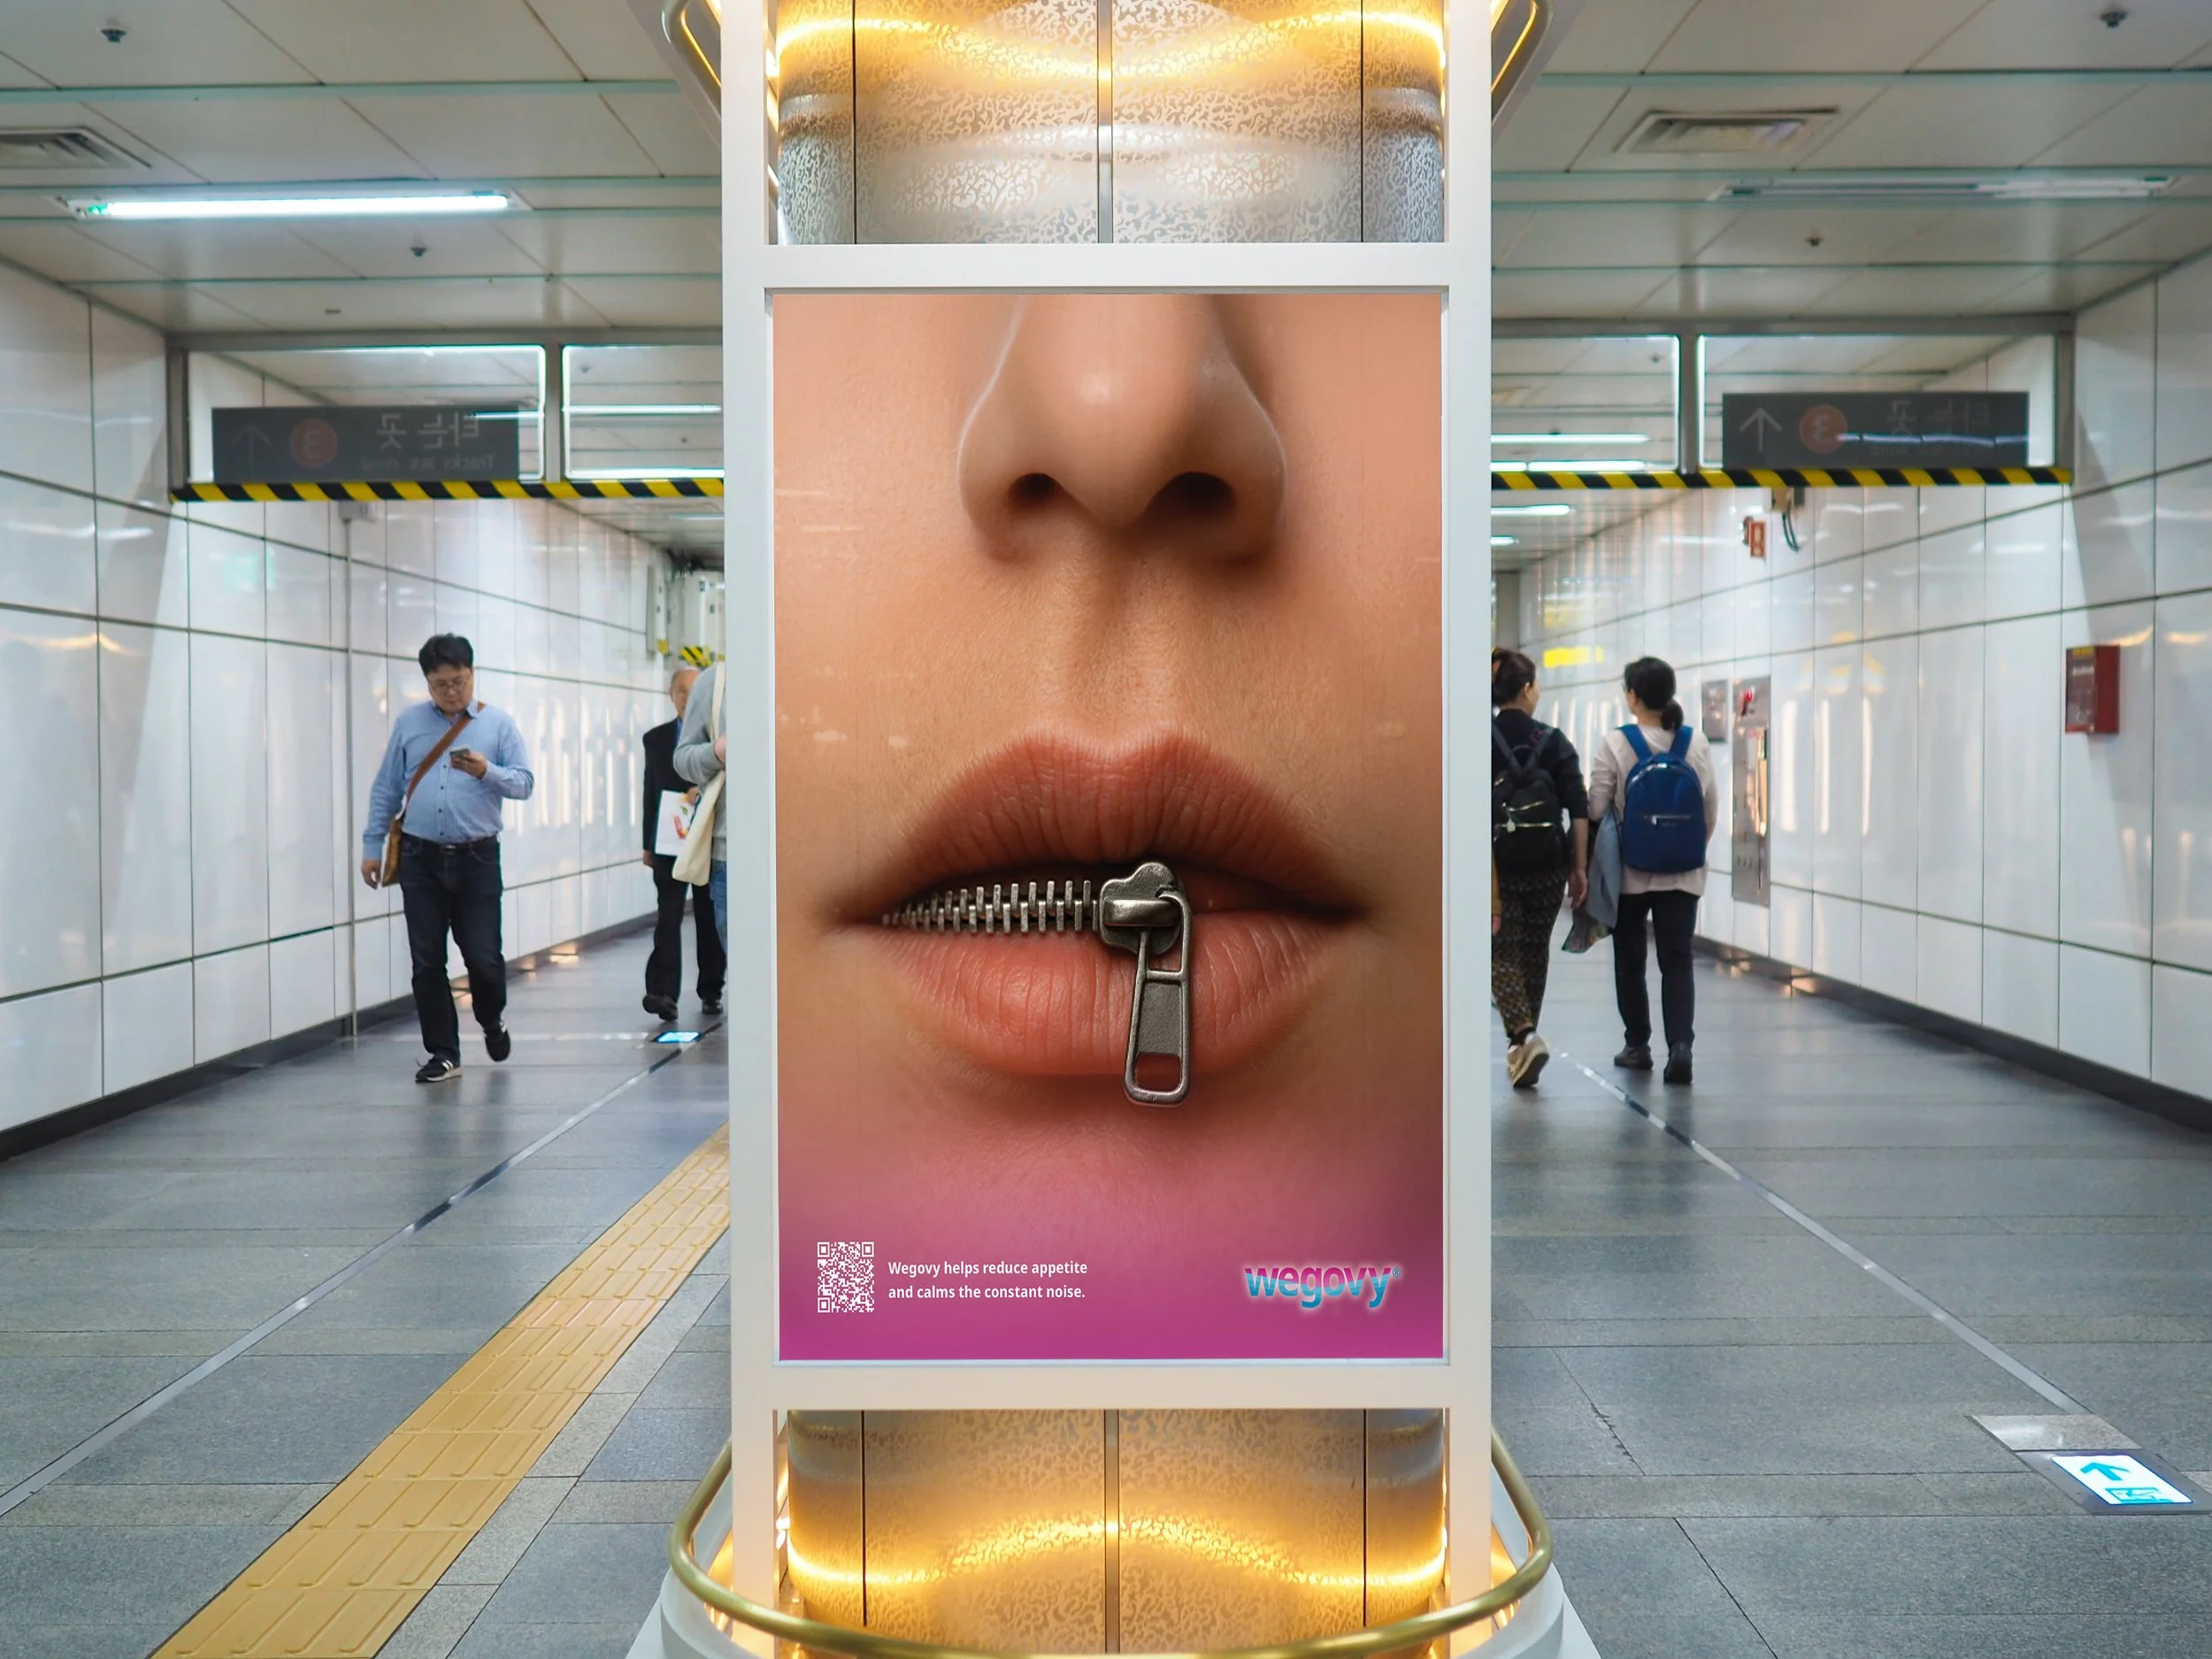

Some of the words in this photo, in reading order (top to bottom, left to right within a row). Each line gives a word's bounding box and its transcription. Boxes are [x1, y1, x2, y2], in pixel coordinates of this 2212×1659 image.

[887, 1261, 941, 1279] Wegovy
[944, 1260, 979, 1279] helps
[983, 1260, 1028, 1274] reduce
[1031, 1260, 1088, 1279] appetite
[888, 1285, 913, 1299] and
[917, 1285, 956, 1299] calms
[958, 1285, 981, 1299] the
[984, 1286, 1043, 1299] constant
[1046, 1284, 1086, 1298] noise.
